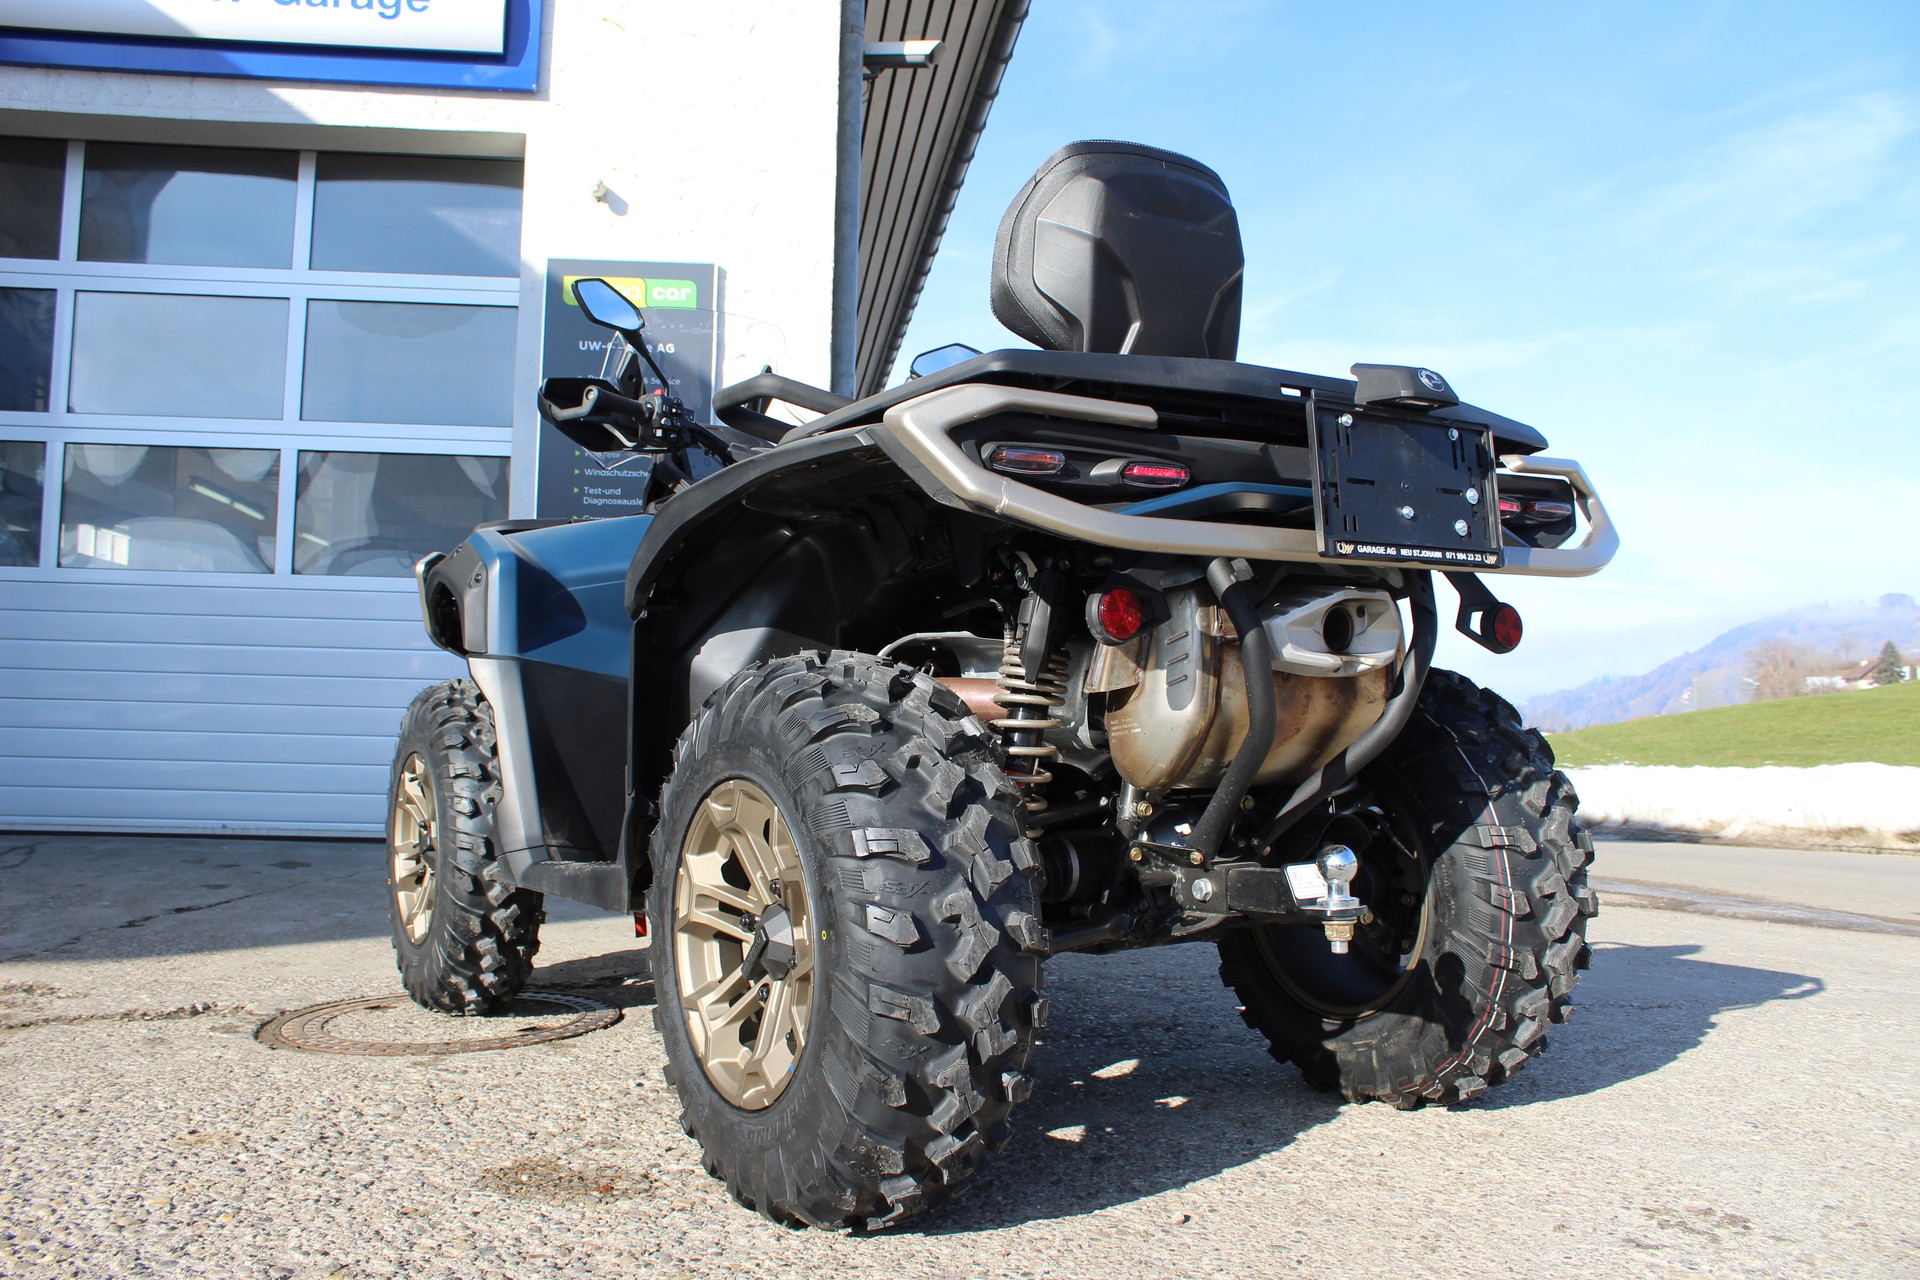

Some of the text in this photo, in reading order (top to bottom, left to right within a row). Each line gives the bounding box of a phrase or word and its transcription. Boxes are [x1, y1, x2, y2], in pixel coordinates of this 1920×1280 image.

[652, 286, 691, 301] car
[657, 343, 675, 353] AG
[650, 377, 680, 385] Seice
[584, 486, 621, 495] Test-und
[1357, 544, 1386, 554] GARAGE
[1386, 546, 1397, 555] AG
[1400, 548, 1412, 556] NEU
